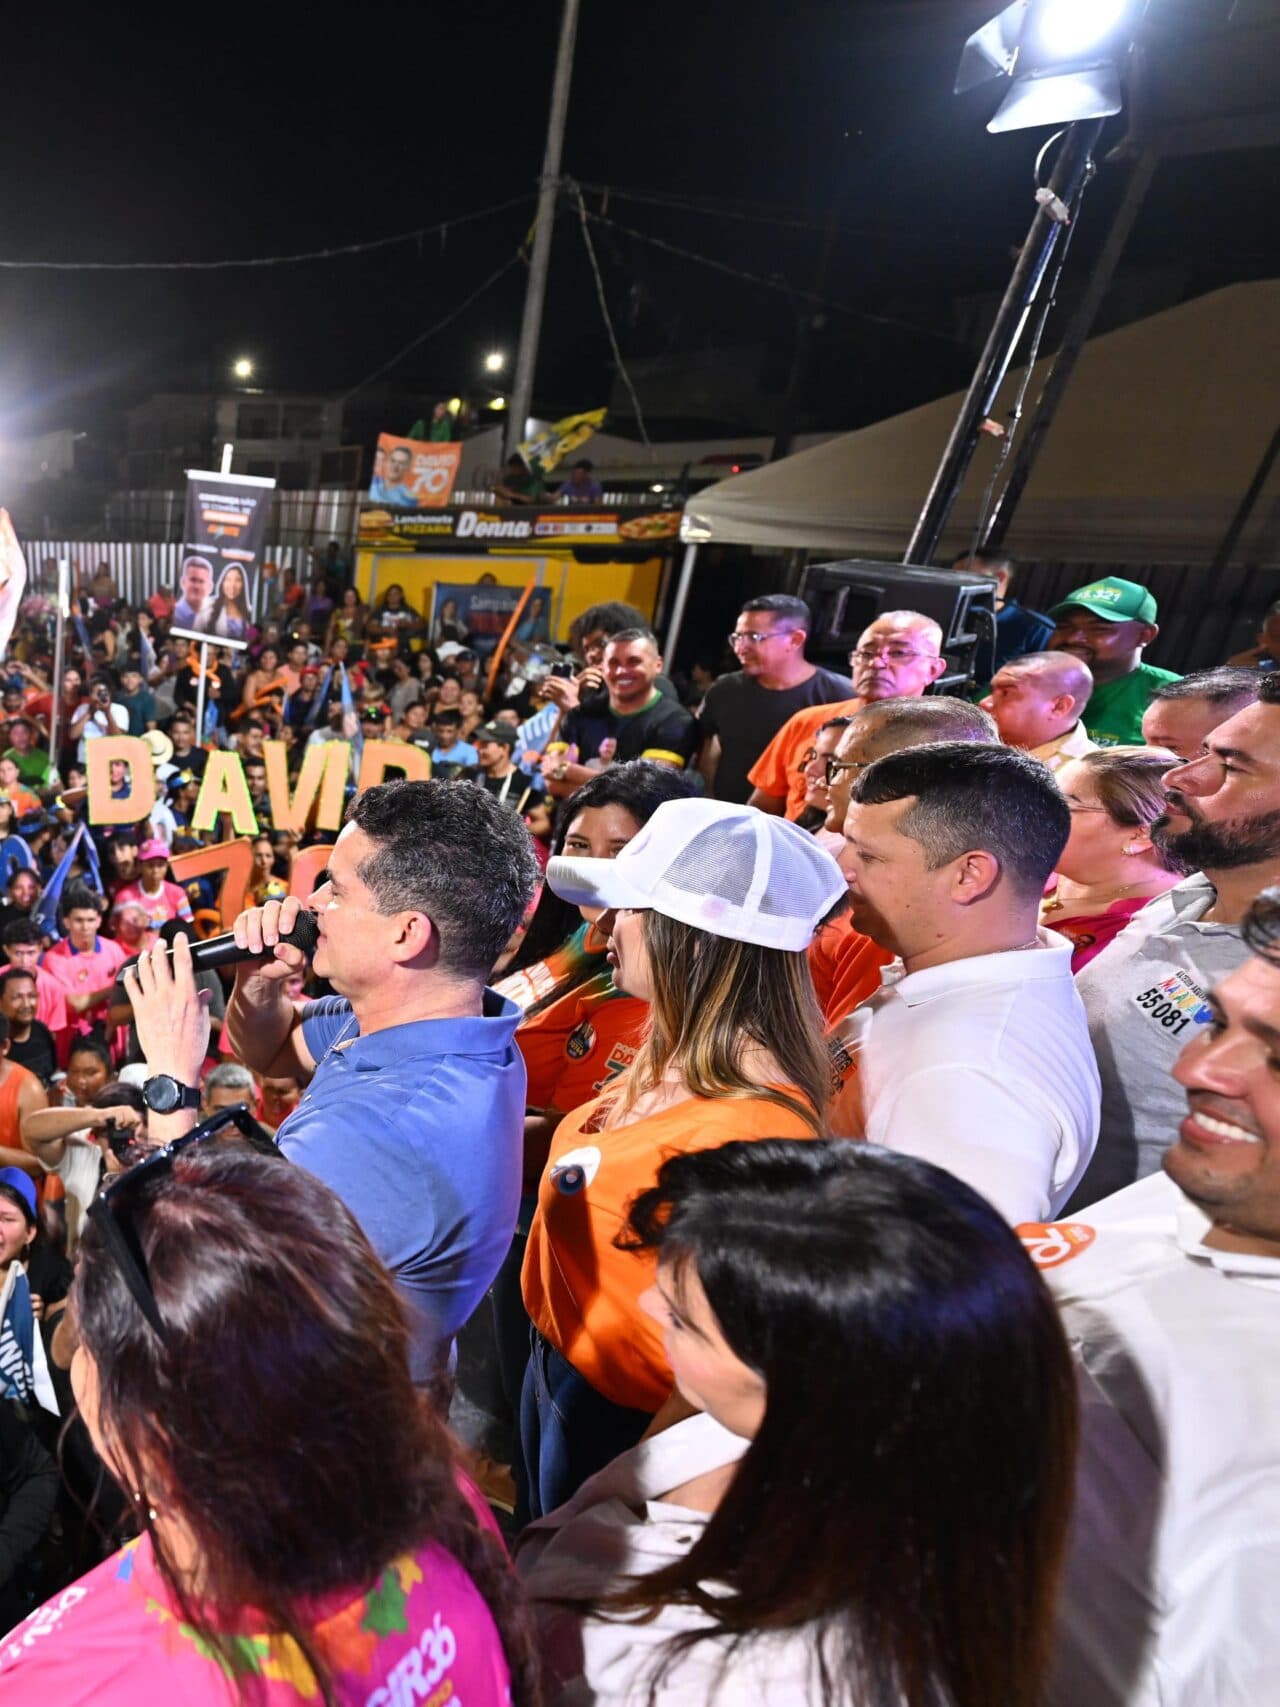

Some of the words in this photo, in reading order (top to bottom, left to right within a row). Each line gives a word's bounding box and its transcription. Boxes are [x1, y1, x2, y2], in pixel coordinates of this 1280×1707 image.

[412, 465, 449, 494] 70
[456, 510, 532, 538] Donna
[1136, 987, 1191, 1036] 55081
